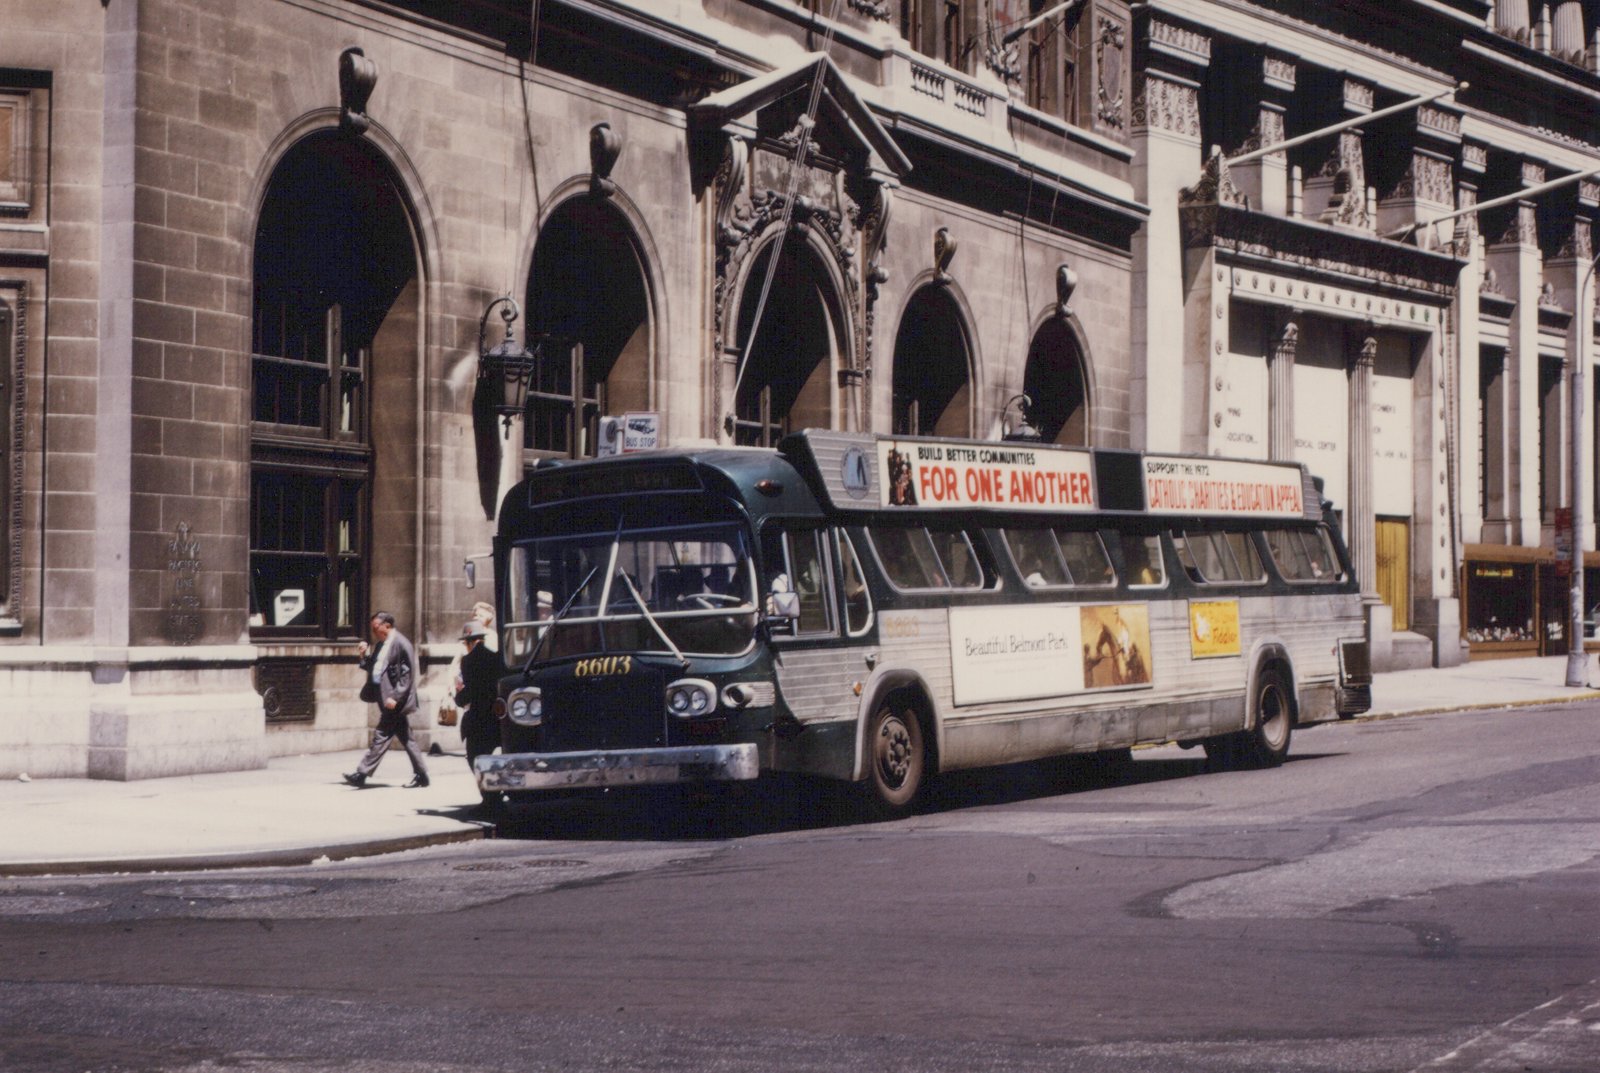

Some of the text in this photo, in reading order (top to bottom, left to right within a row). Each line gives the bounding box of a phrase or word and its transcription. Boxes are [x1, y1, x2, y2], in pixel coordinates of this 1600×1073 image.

[625, 436, 657, 448] BUS STOP
[918, 446, 1036, 466] BUILD BETTER COMMUNITIES
[1146, 462, 1210, 477] SUPPORT THE 1972
[919, 465, 1094, 505] FOR ONE ANOTHER
[1148, 479, 1187, 510] CATHOLIC
[1188, 480, 1229, 511] CHARITIES
[1237, 482, 1275, 513] EDUCATION
[1276, 484, 1302, 513] APPEAL
[168, 560, 201, 573] PACIFIC
[175, 578, 193, 590] LINE
[964, 631, 1069, 656] Beautiful Belmont Park
[574, 655, 632, 677] 8603
